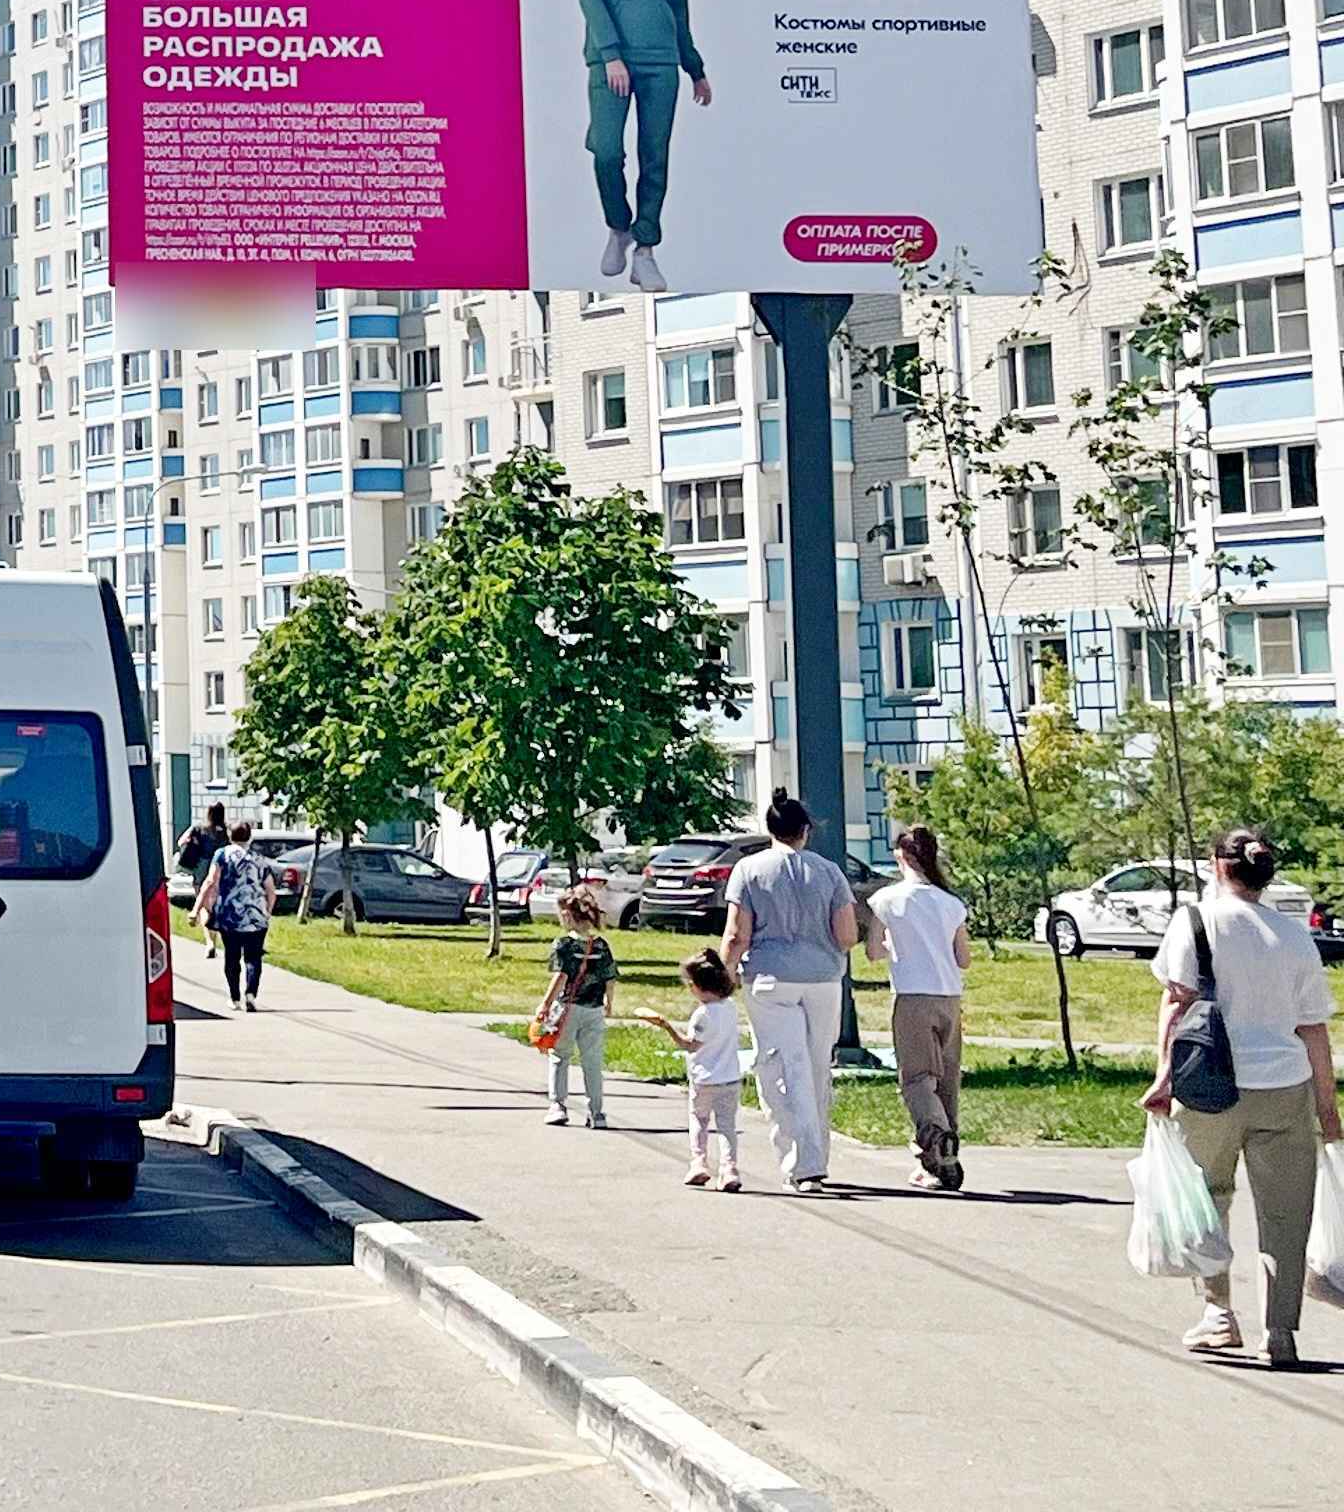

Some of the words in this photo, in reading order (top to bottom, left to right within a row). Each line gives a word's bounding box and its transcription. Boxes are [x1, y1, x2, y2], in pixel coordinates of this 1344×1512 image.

[143, 7, 307, 28] БОЛЬШАЯ
[774, 13, 865, 31] Костюмы
[871, 19, 987, 35] спортивные
[143, 36, 384, 61] РАСПРОДАЖА
[775, 41, 858, 55] женские
[143, 66, 298, 91] ОДЕЖДЫ
[797, 225, 861, 238] ОПЛАТА
[866, 225, 924, 238] ПОСЛЕ
